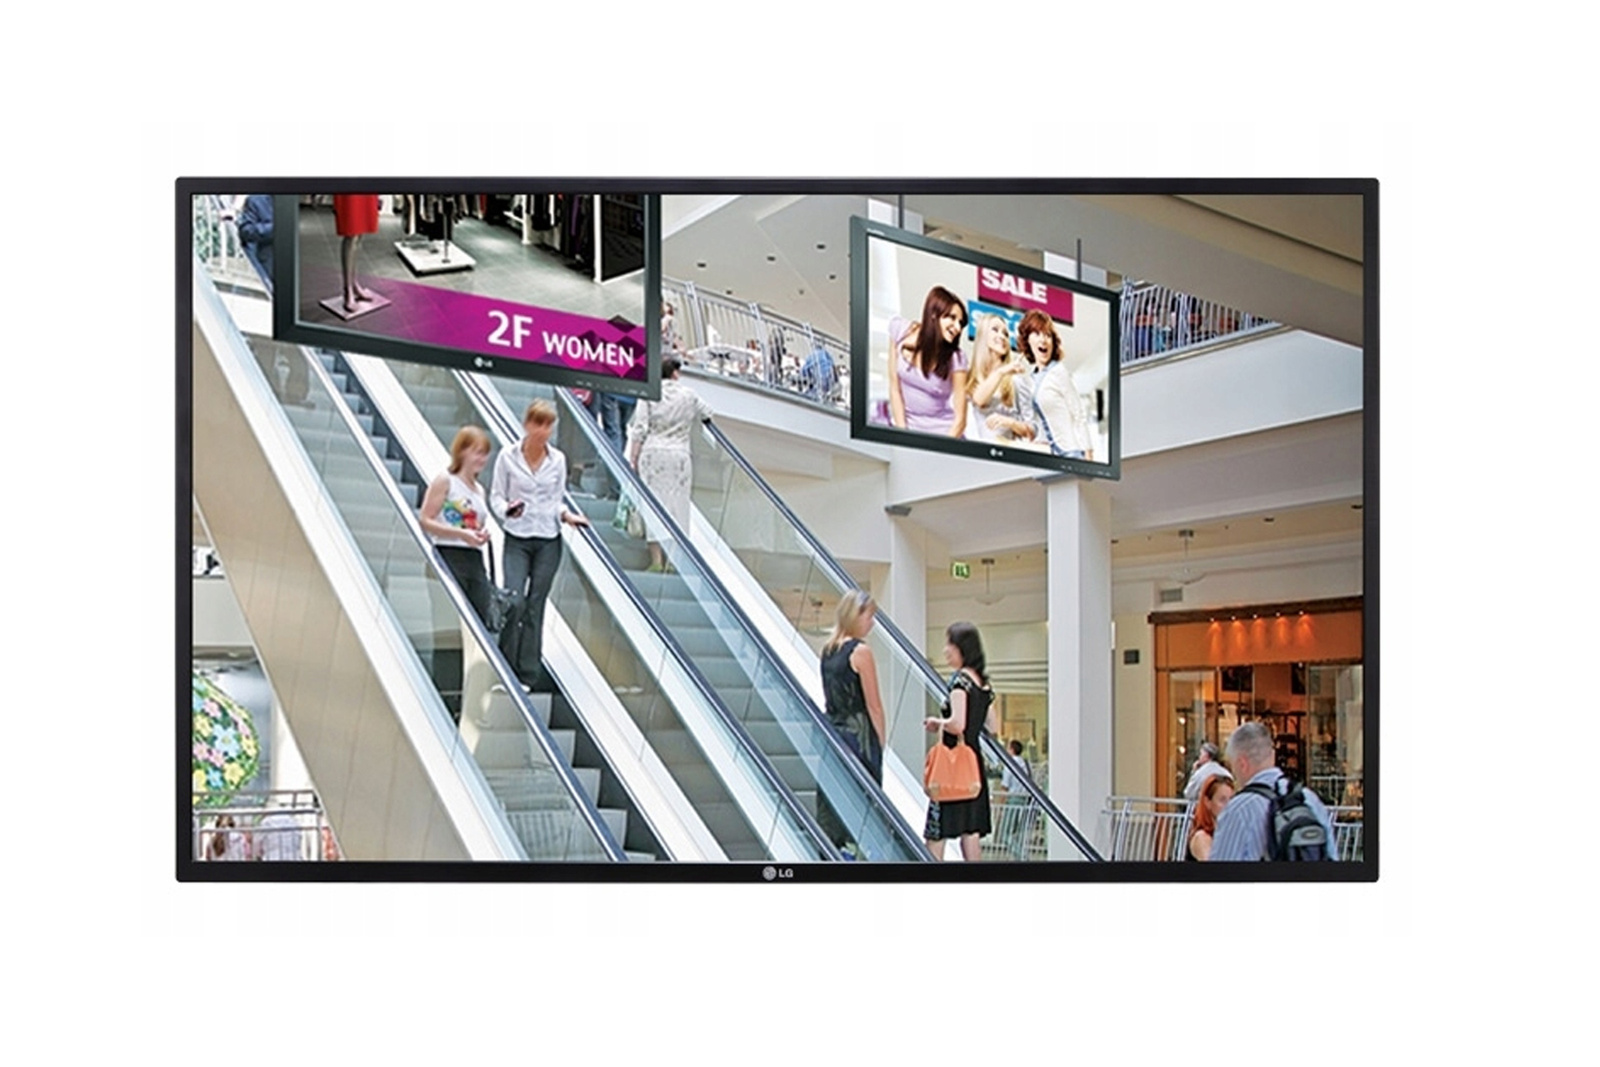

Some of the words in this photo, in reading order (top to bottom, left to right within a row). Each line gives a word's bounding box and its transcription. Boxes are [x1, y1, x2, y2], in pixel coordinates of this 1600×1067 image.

[981, 267, 1048, 305] SALE
[487, 309, 533, 349] 2F
[541, 330, 635, 368] WOMEN
